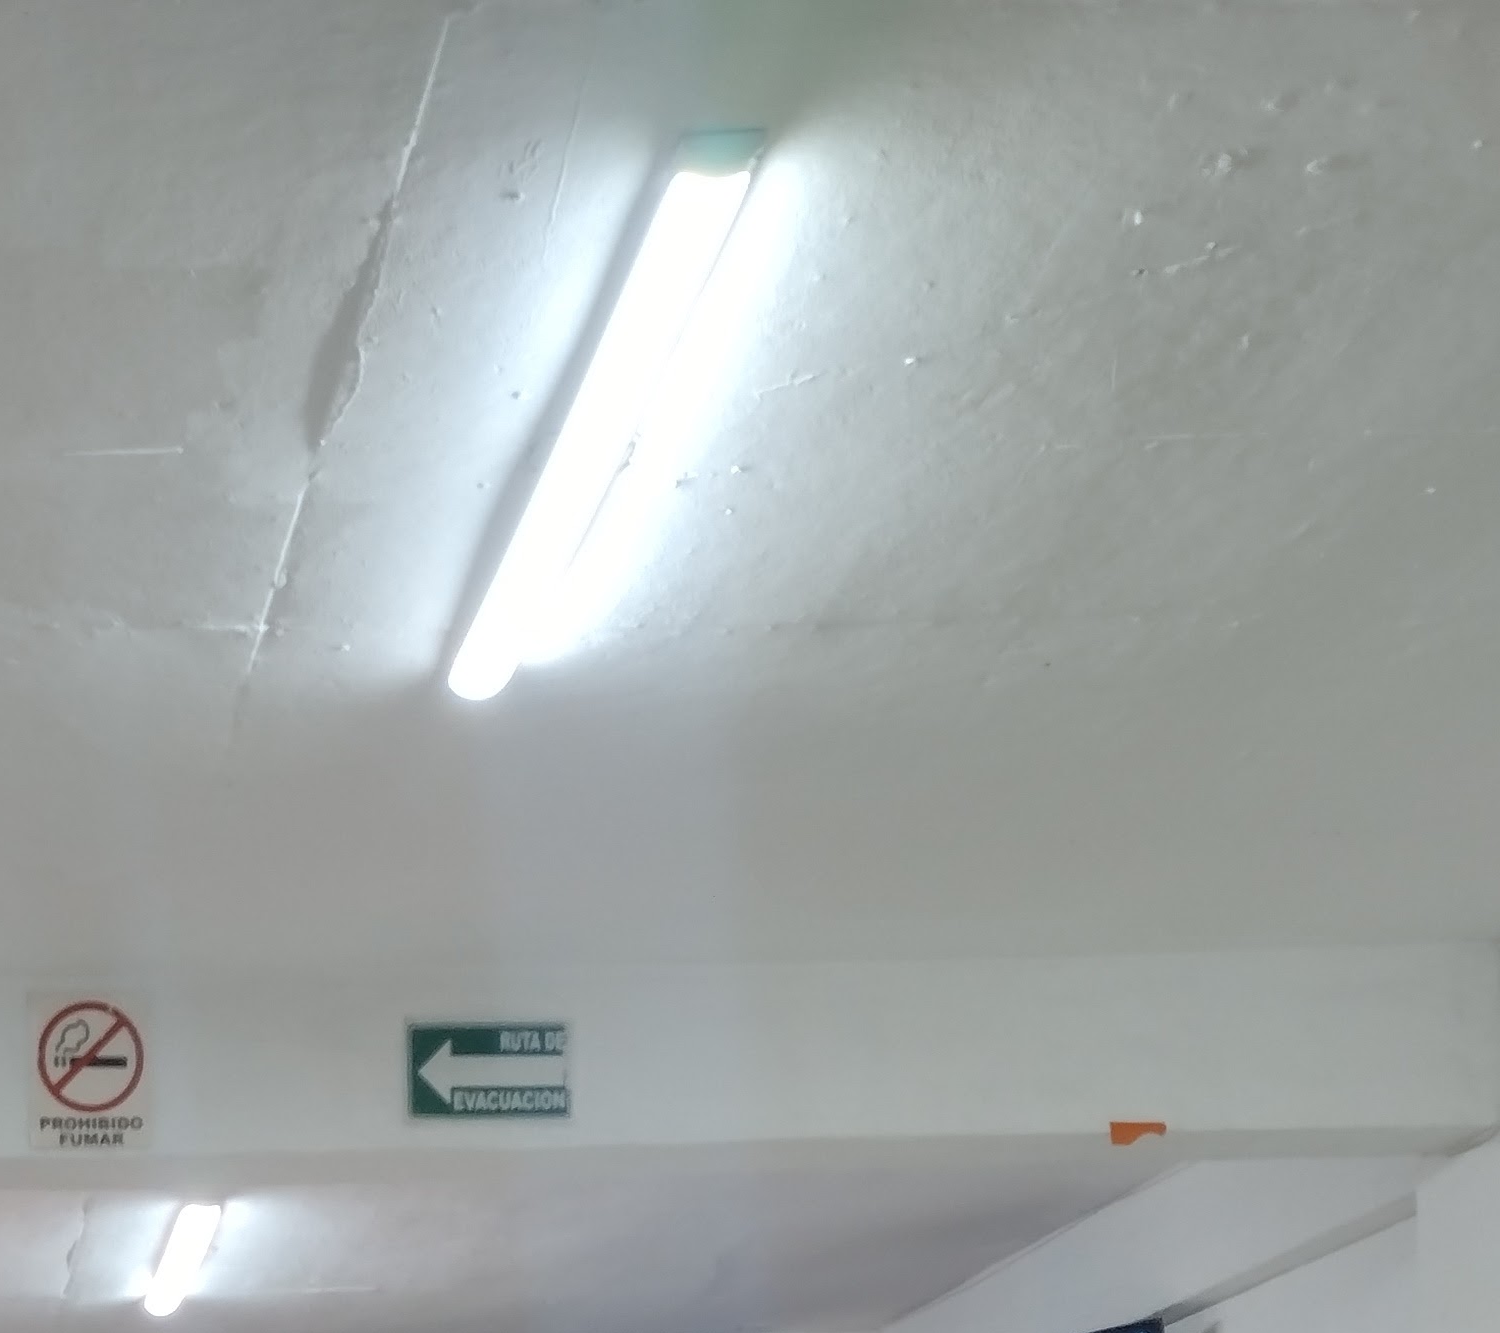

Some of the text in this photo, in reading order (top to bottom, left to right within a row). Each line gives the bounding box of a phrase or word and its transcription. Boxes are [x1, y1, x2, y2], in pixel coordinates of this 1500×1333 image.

[500, 1031, 567, 1052] RUTA DE
[39, 1116, 144, 1131] PROHIBIDO
[59, 1133, 125, 1147] FUMAR
